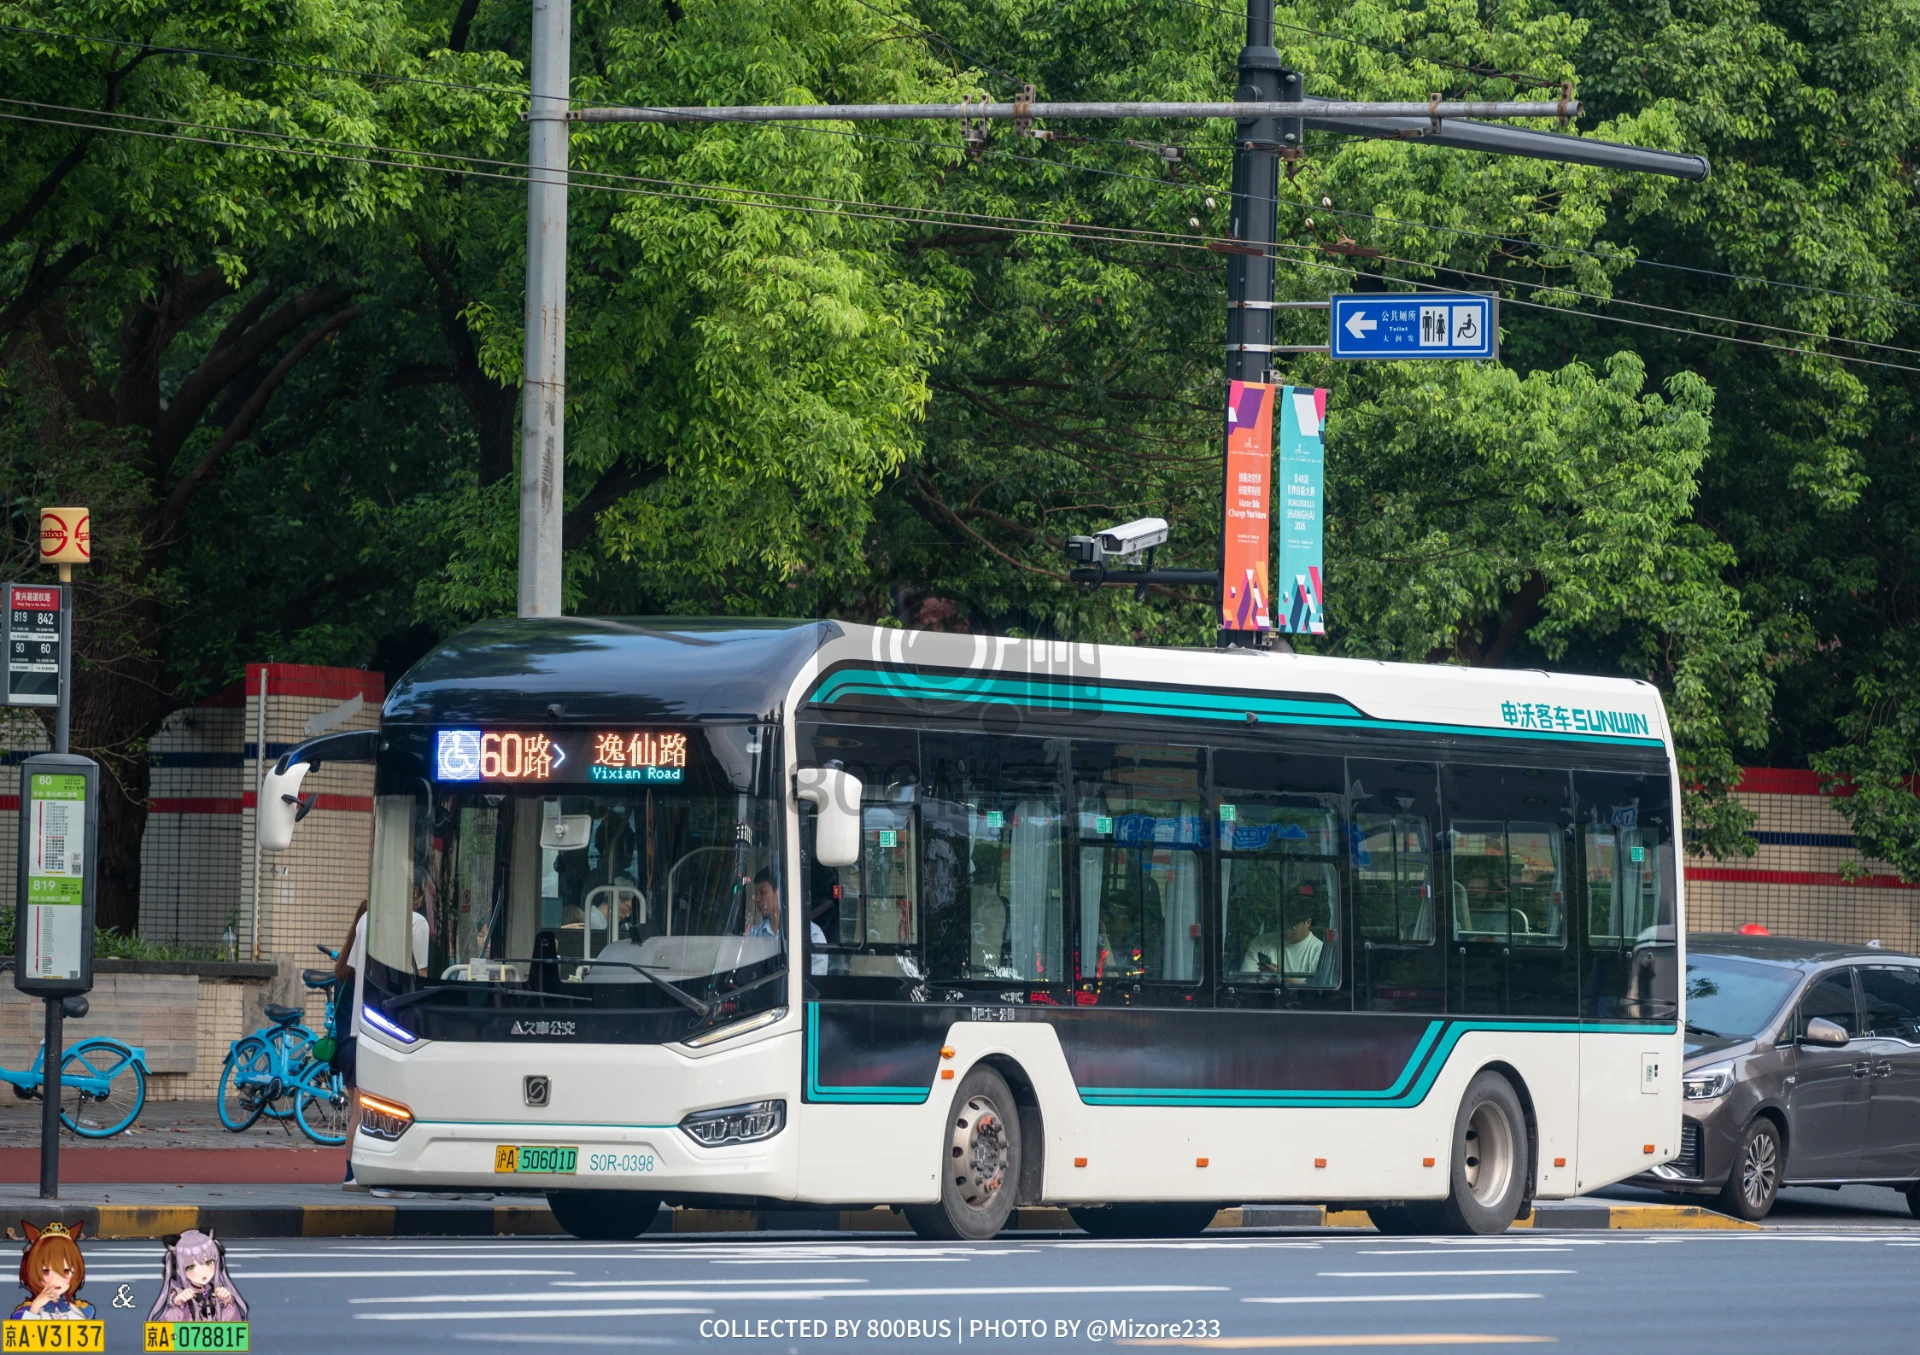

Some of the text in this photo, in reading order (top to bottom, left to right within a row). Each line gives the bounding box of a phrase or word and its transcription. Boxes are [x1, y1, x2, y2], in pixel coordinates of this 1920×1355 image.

[1381, 310, 1416, 322] 公共厕所
[1287, 485, 1315, 497] 世界技能大赛
[1287, 498, 1315, 509] WORLDSKILLS
[1228, 509, 1246, 520] Change
[1287, 509, 1315, 521] SHANGHAI
[1294, 521, 1306, 531] 2026
[15, 591, 51, 603] 黄兴路国权路
[14, 611, 28, 622] 819
[37, 612, 54, 625] 842
[15, 642, 25, 653] 90
[40, 643, 51, 654] 60
[1501, 700, 1649, 735] 申沃客车 SUNWIN
[480, 732, 687, 779] 60路 逸仙路
[592, 766, 680, 780] Yixian Road
[39, 775, 52, 785] 60
[33, 879, 56, 891] 819
